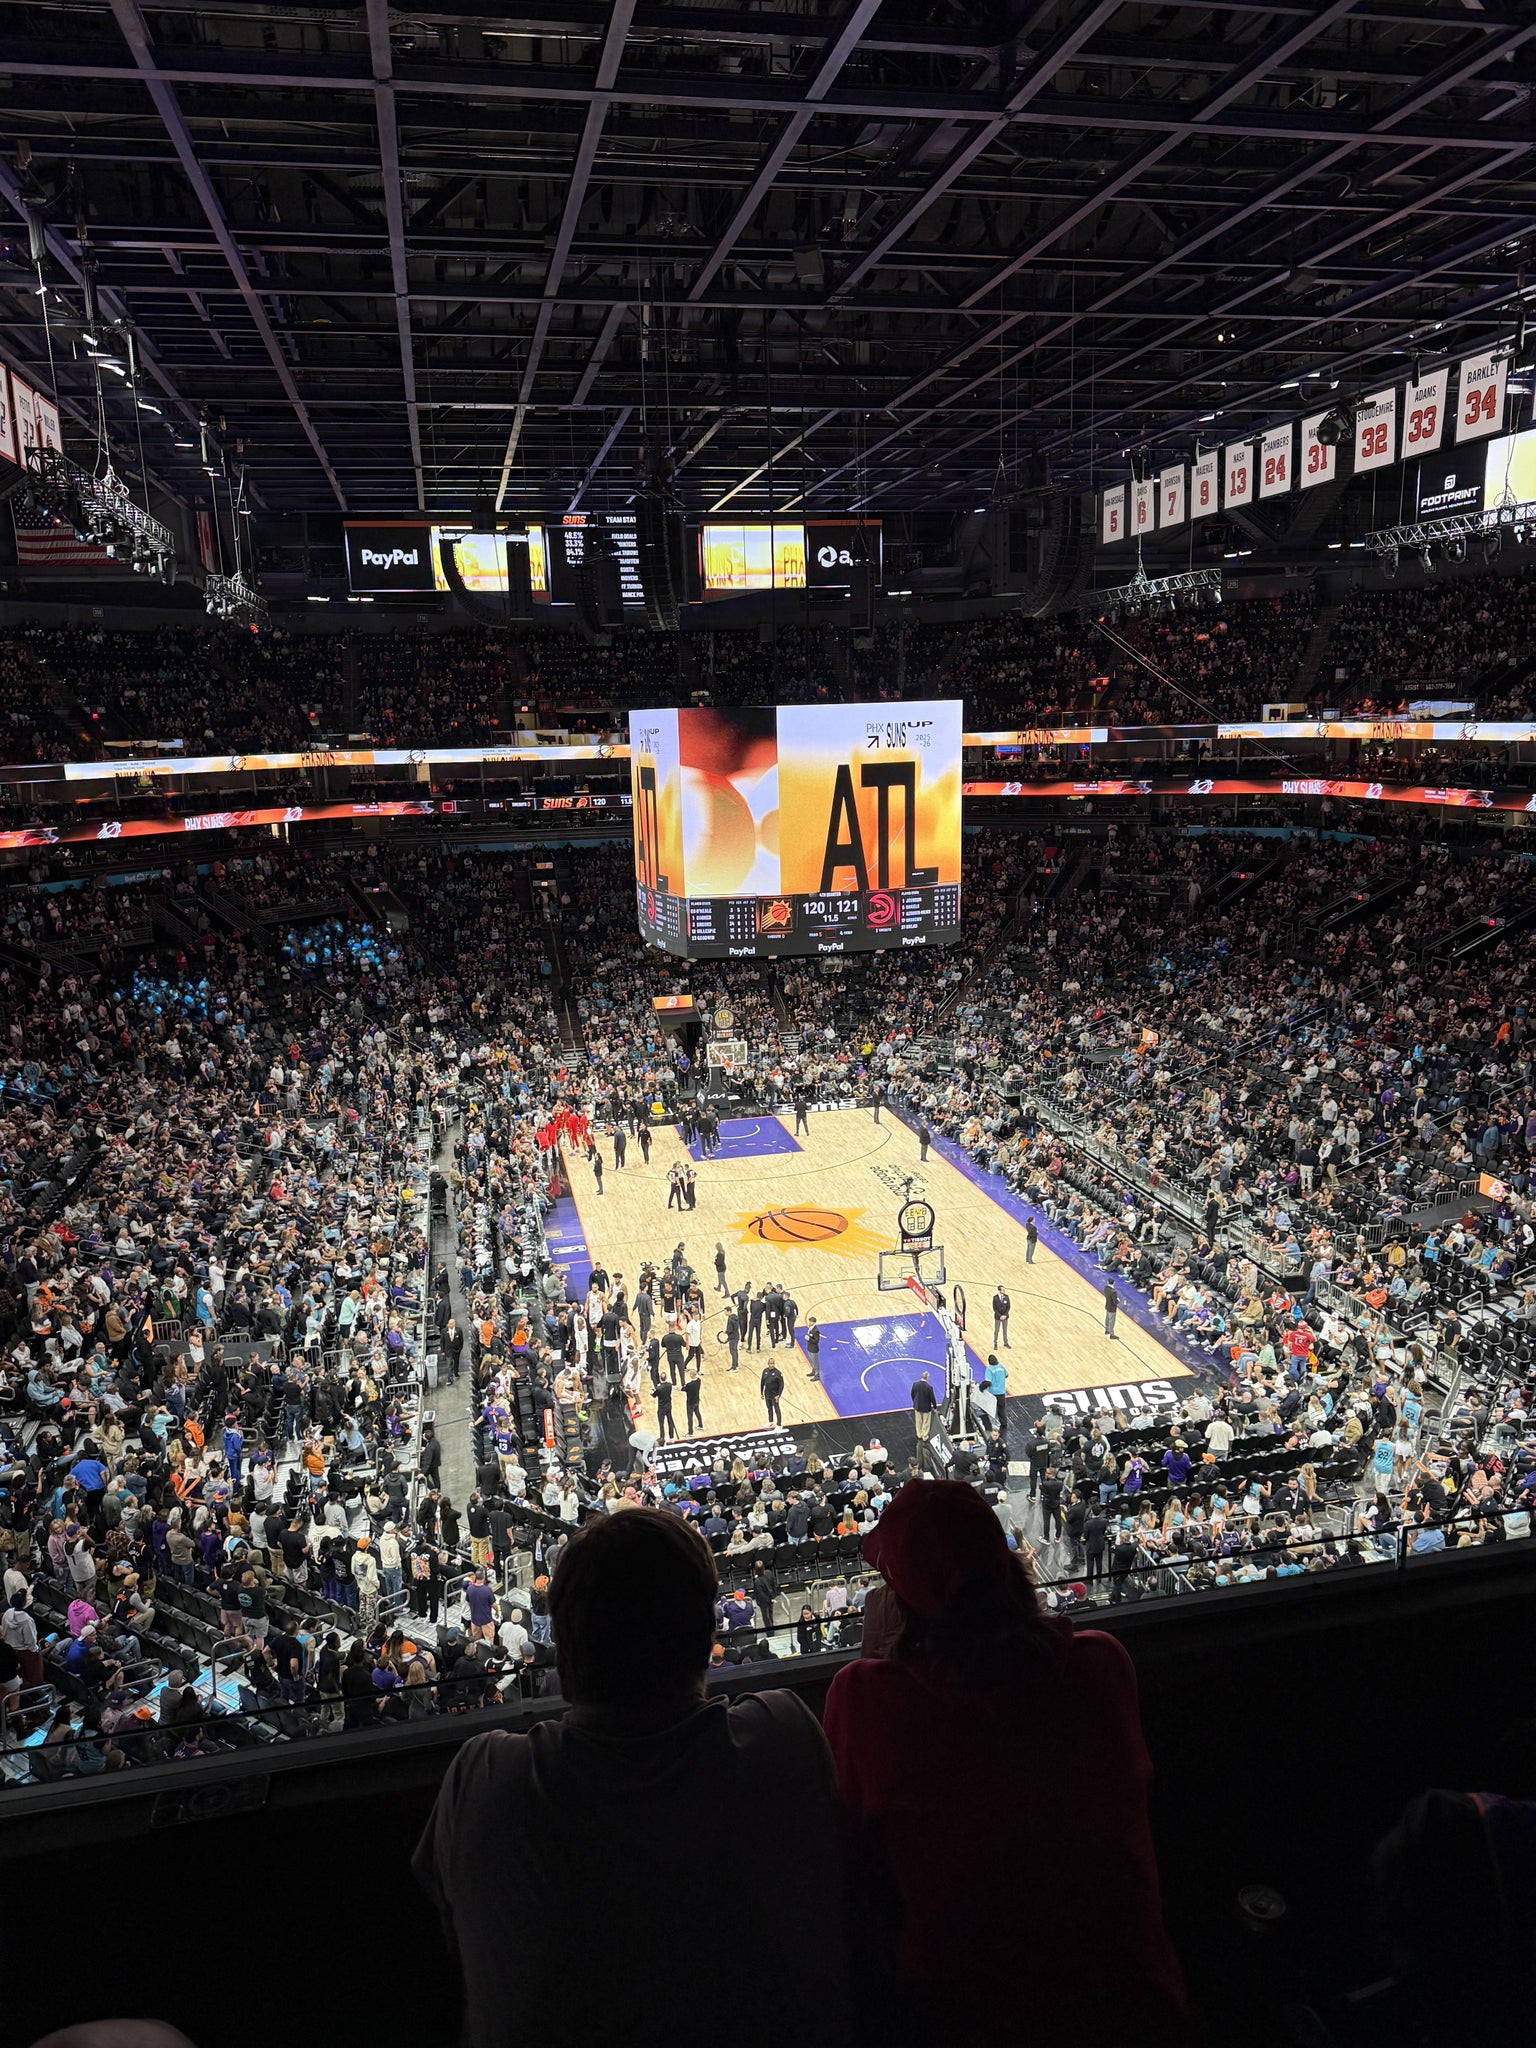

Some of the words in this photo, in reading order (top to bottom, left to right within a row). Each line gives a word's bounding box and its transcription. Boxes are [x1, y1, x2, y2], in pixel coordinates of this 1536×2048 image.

[1467, 362, 1500, 384] BARKLEY
[1414, 385, 1436, 402] ADAMS
[1357, 400, 1394, 422] STOUDEMIRE
[1464, 384, 1496, 425] 34
[1408, 405, 1436, 442] 33
[1264, 436, 1290, 452] CHAMBERS
[1362, 423, 1387, 458] 32
[1233, 452, 1245, 464] NASH
[1308, 444, 1328, 474] 31
[1196, 462, 1214, 476] MAJERLE
[1265, 454, 1286, 485] 24
[1164, 475, 1181, 488] JOHNSON
[1230, 468, 1246, 496] 13
[1168, 491, 1176, 516] 7
[1200, 480, 1209, 506] 9
[1420, 487, 1478, 508] FOOTPRINT
[562, 515, 586, 524] SUNS
[1110, 510, 1117, 532] 5
[1138, 501, 1146, 524] 6
[362, 549, 418, 570] PayPal
[867, 723, 884, 733] PHX
[886, 722, 906, 748] SUNS
[543, 798, 572, 809] SUNS
[820, 762, 939, 891] ATL
[803, 902, 825, 914] 120
[836, 900, 858, 913] 121
[729, 947, 755, 956] PayPal
[818, 943, 844, 952] PayPal
[902, 936, 926, 946] PayPal
[1042, 1380, 1178, 1417] SUNS
[728, 1437, 794, 1450] RESORTS
[1378, 1451, 1388, 1459] 22
[1135, 1470, 1139, 1478] 1
